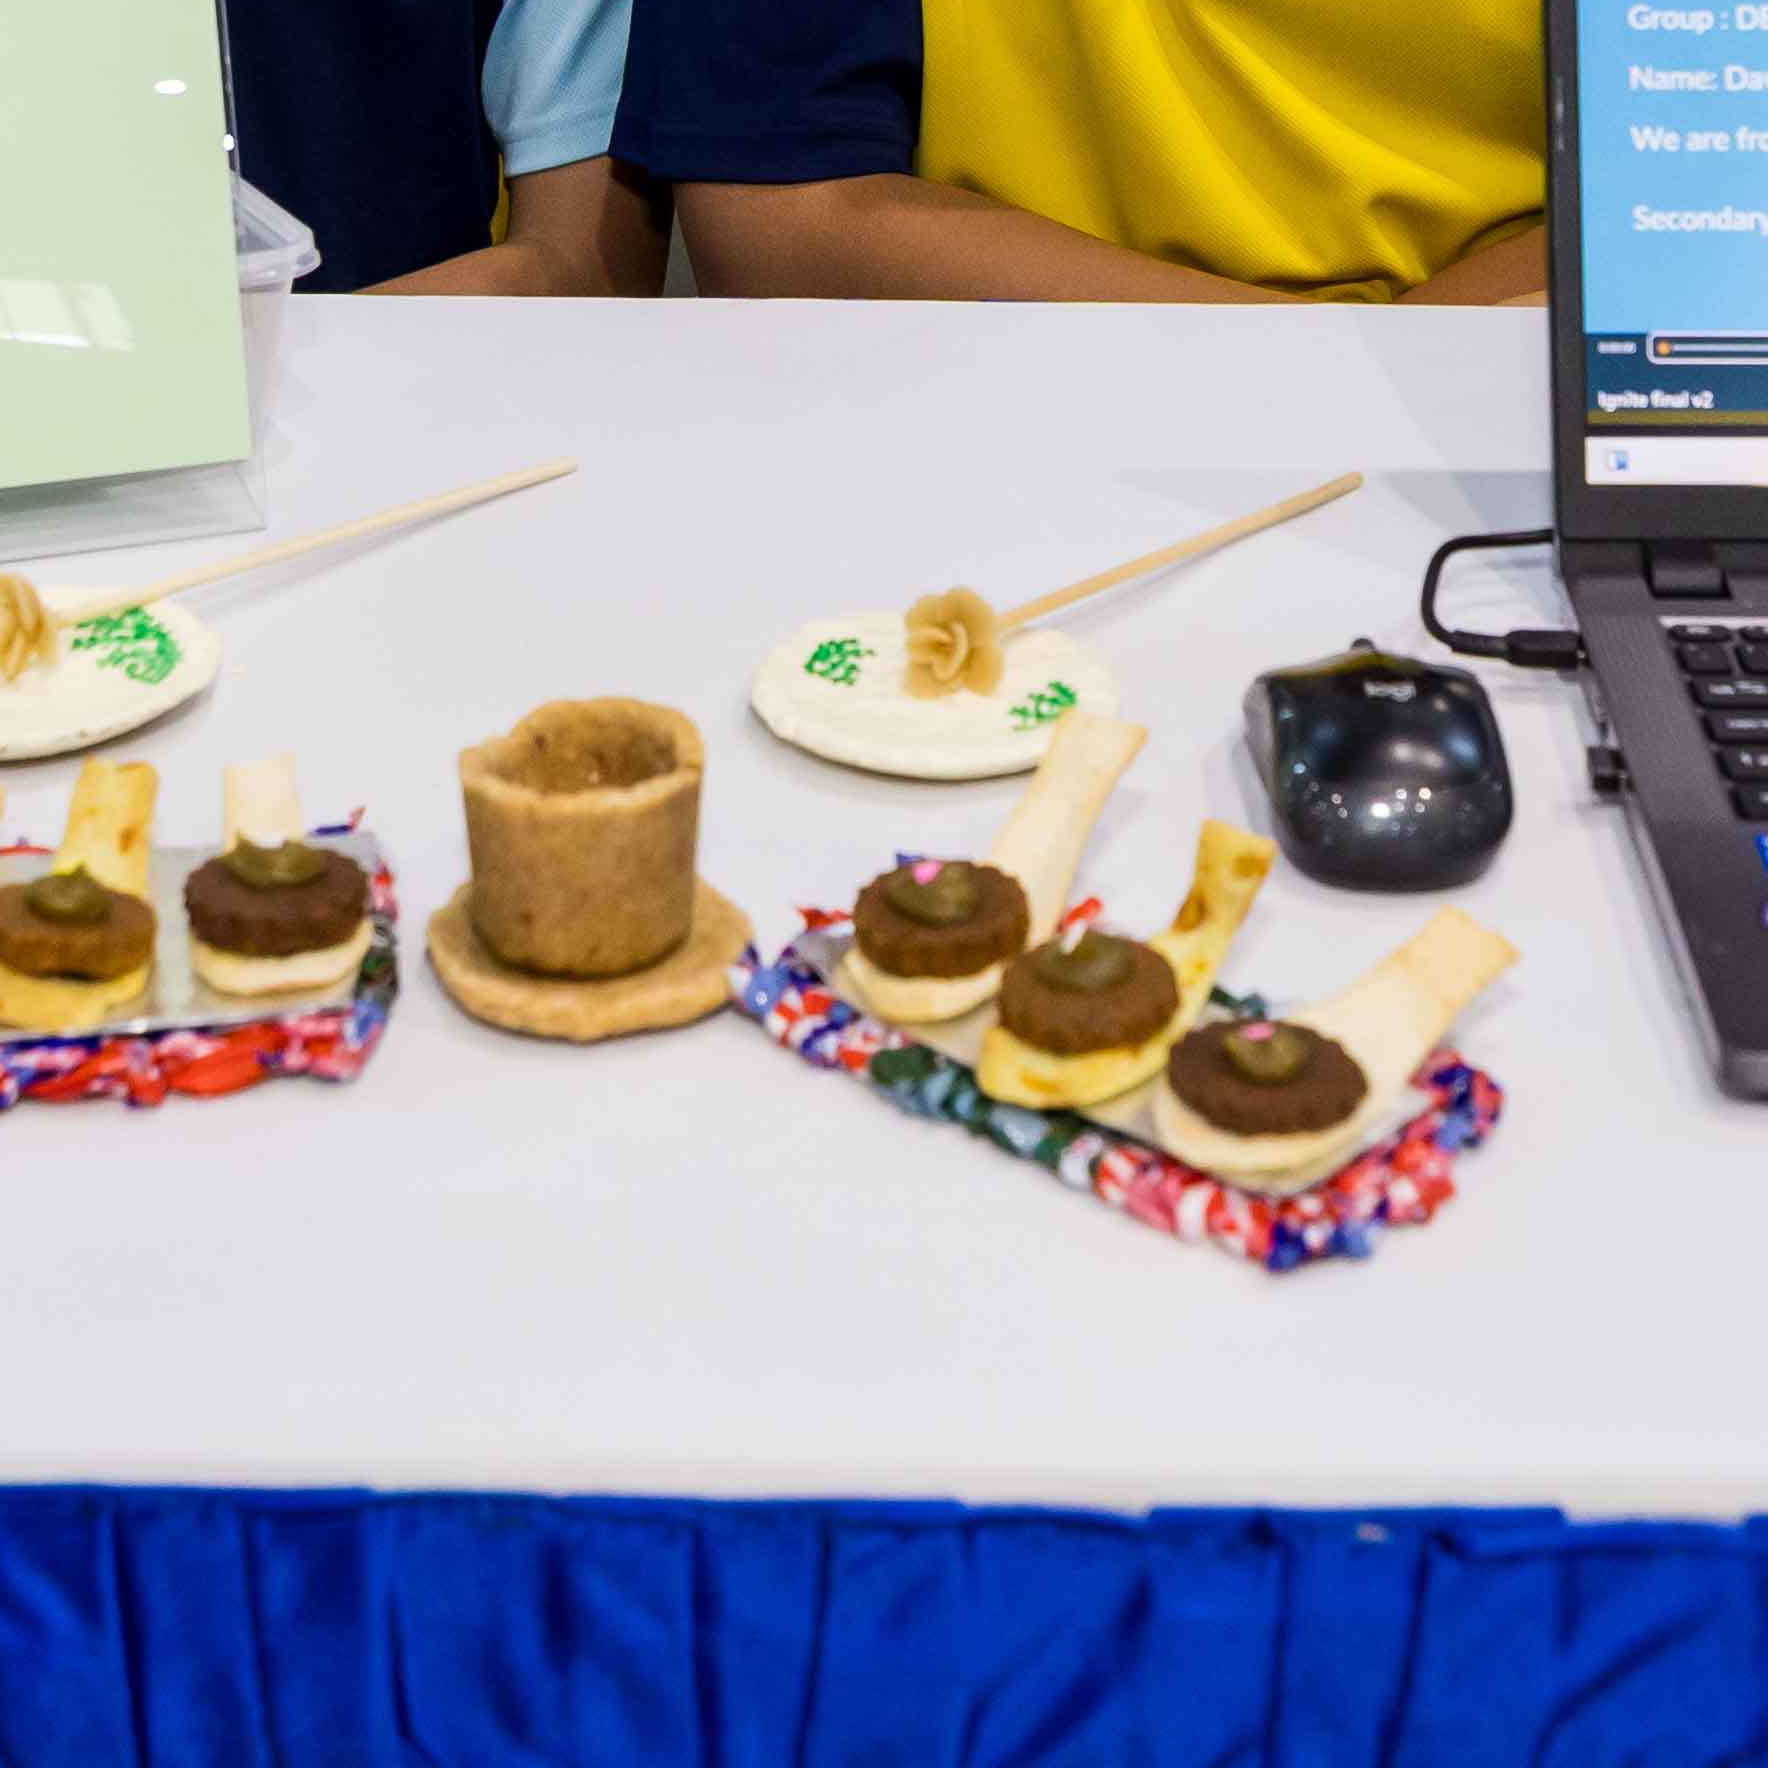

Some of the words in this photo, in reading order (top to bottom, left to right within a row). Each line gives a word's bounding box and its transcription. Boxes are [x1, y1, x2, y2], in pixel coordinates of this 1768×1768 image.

[1626, 3, 1715, 35] Group
[1628, 65, 1717, 91] Name:
[1630, 126, 1680, 152] We
[1686, 131, 1730, 152] are
[1650, 389, 1690, 409] final
[1690, 390, 1714, 409] v2
